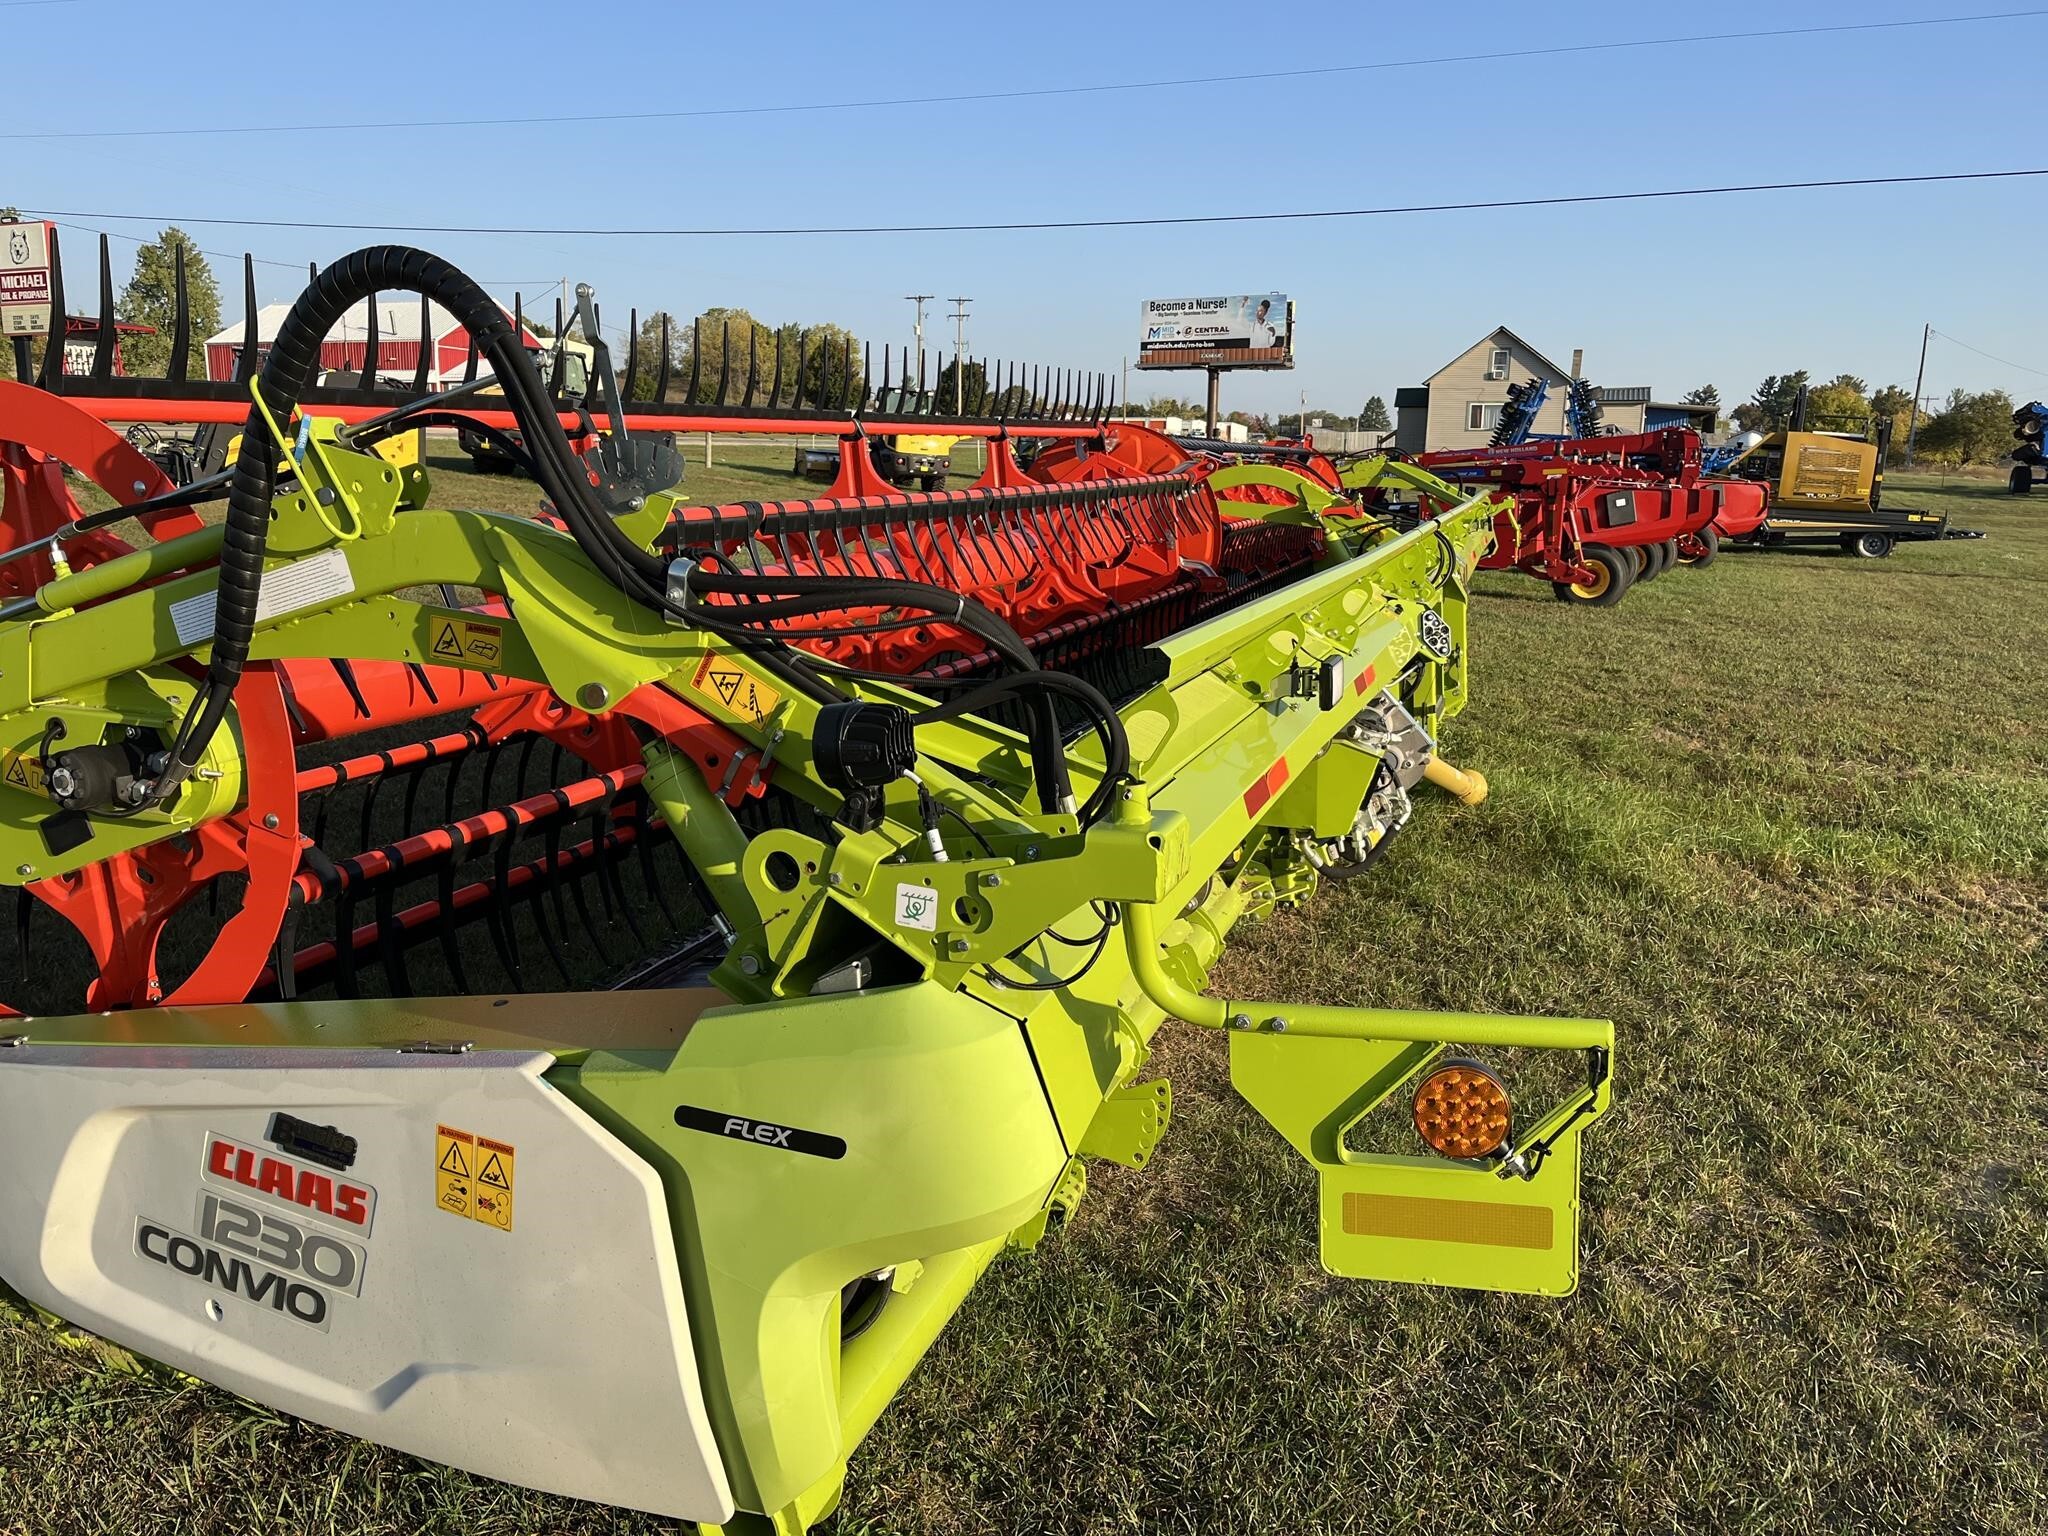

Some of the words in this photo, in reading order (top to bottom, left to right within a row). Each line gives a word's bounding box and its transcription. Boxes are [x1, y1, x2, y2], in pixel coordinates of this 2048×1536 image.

[1, 274, 46, 289] MICHAEL
[1, 292, 12, 300] OIL
[12, 291, 18, 300] &
[18, 290, 48, 300] PROPANE
[1149, 301, 1186, 312] Become
[1187, 302, 1194, 310] a
[1195, 298, 1227, 310] Nurse!
[1194, 326, 1230, 334] CENTRAL
[1146, 342, 1215, 350] midmich.edu/rn-to-bsn
[1510, 445, 1538, 454] HOLLAND
[723, 1118, 793, 1147] FLEX
[208, 1140, 370, 1226] CLAAS
[200, 1195, 357, 1288] 1230
[138, 1224, 327, 1324] CONVIO
